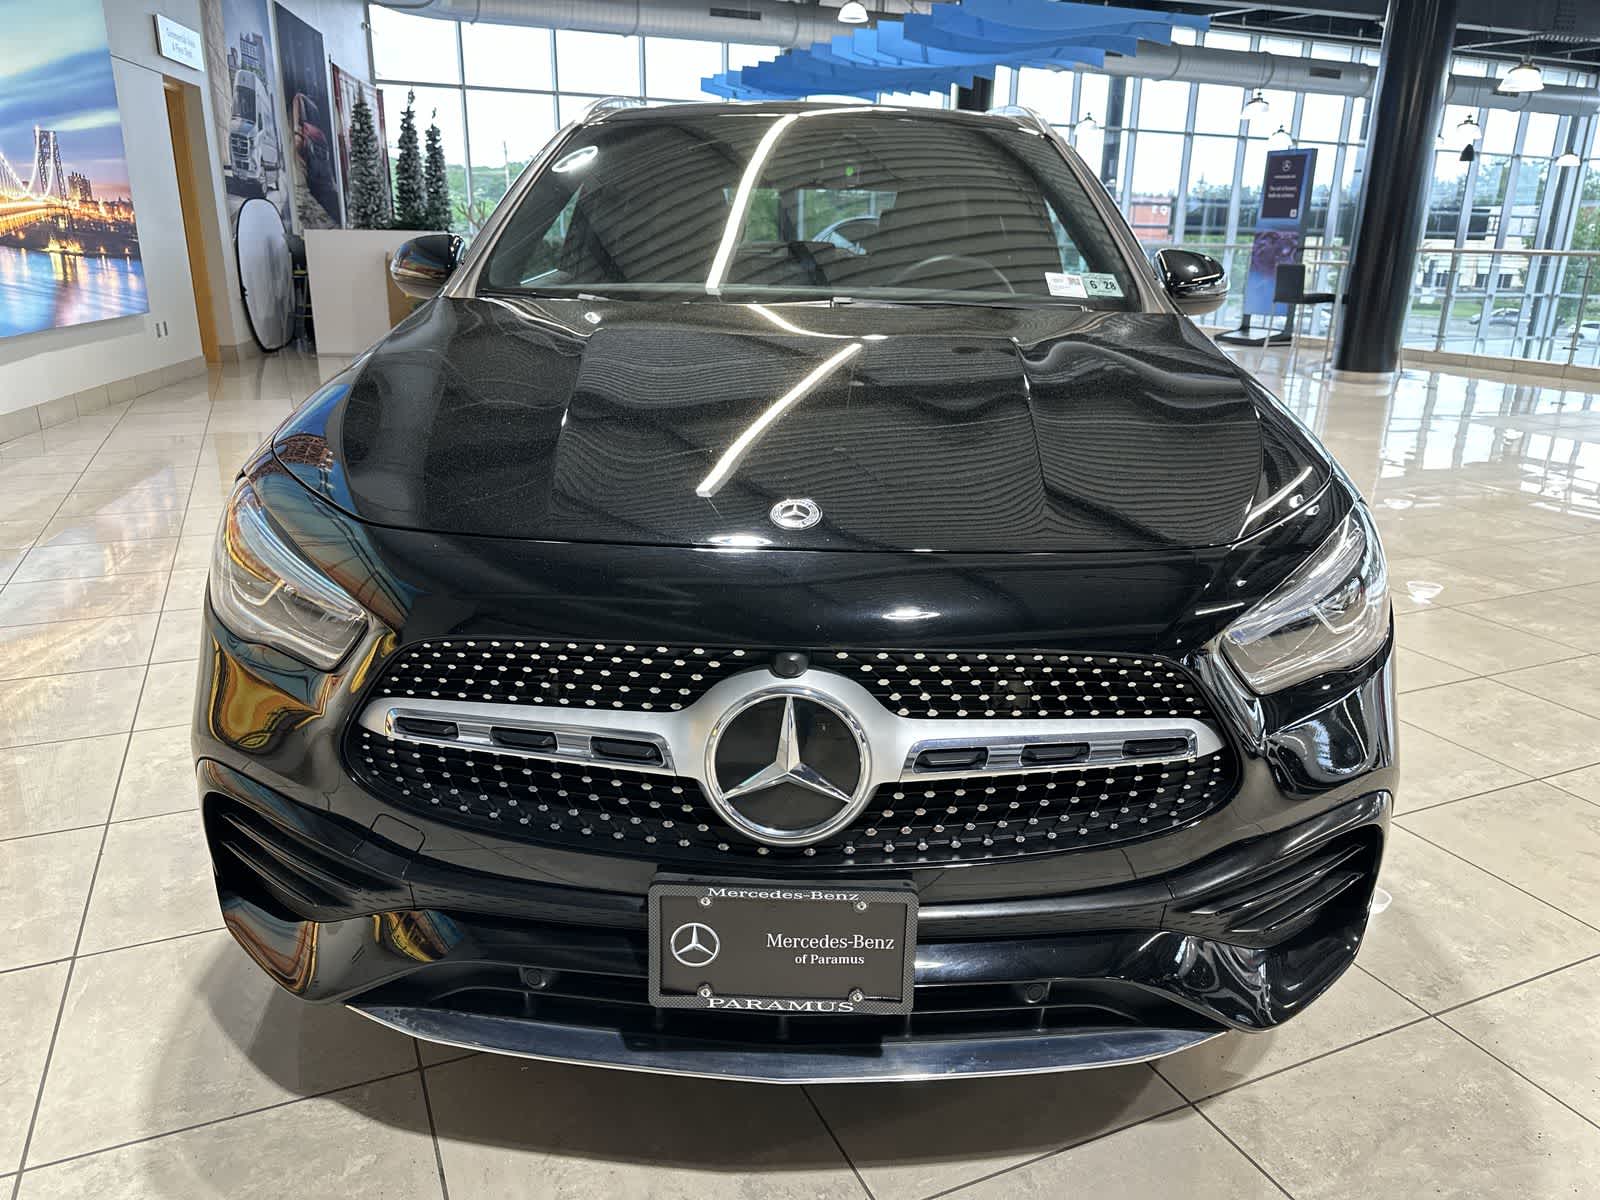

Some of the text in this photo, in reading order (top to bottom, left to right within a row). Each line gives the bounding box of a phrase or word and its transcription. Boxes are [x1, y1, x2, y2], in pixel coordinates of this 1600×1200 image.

[1089, 280, 1098, 290] 6
[1103, 280, 1117, 291] 28
[707, 887, 861, 901] Mercedes-Benz
[766, 933, 895, 950] Mercedes-Benz
[794, 953, 865, 965] of Paramus
[706, 997, 855, 1013] PARAMUS
